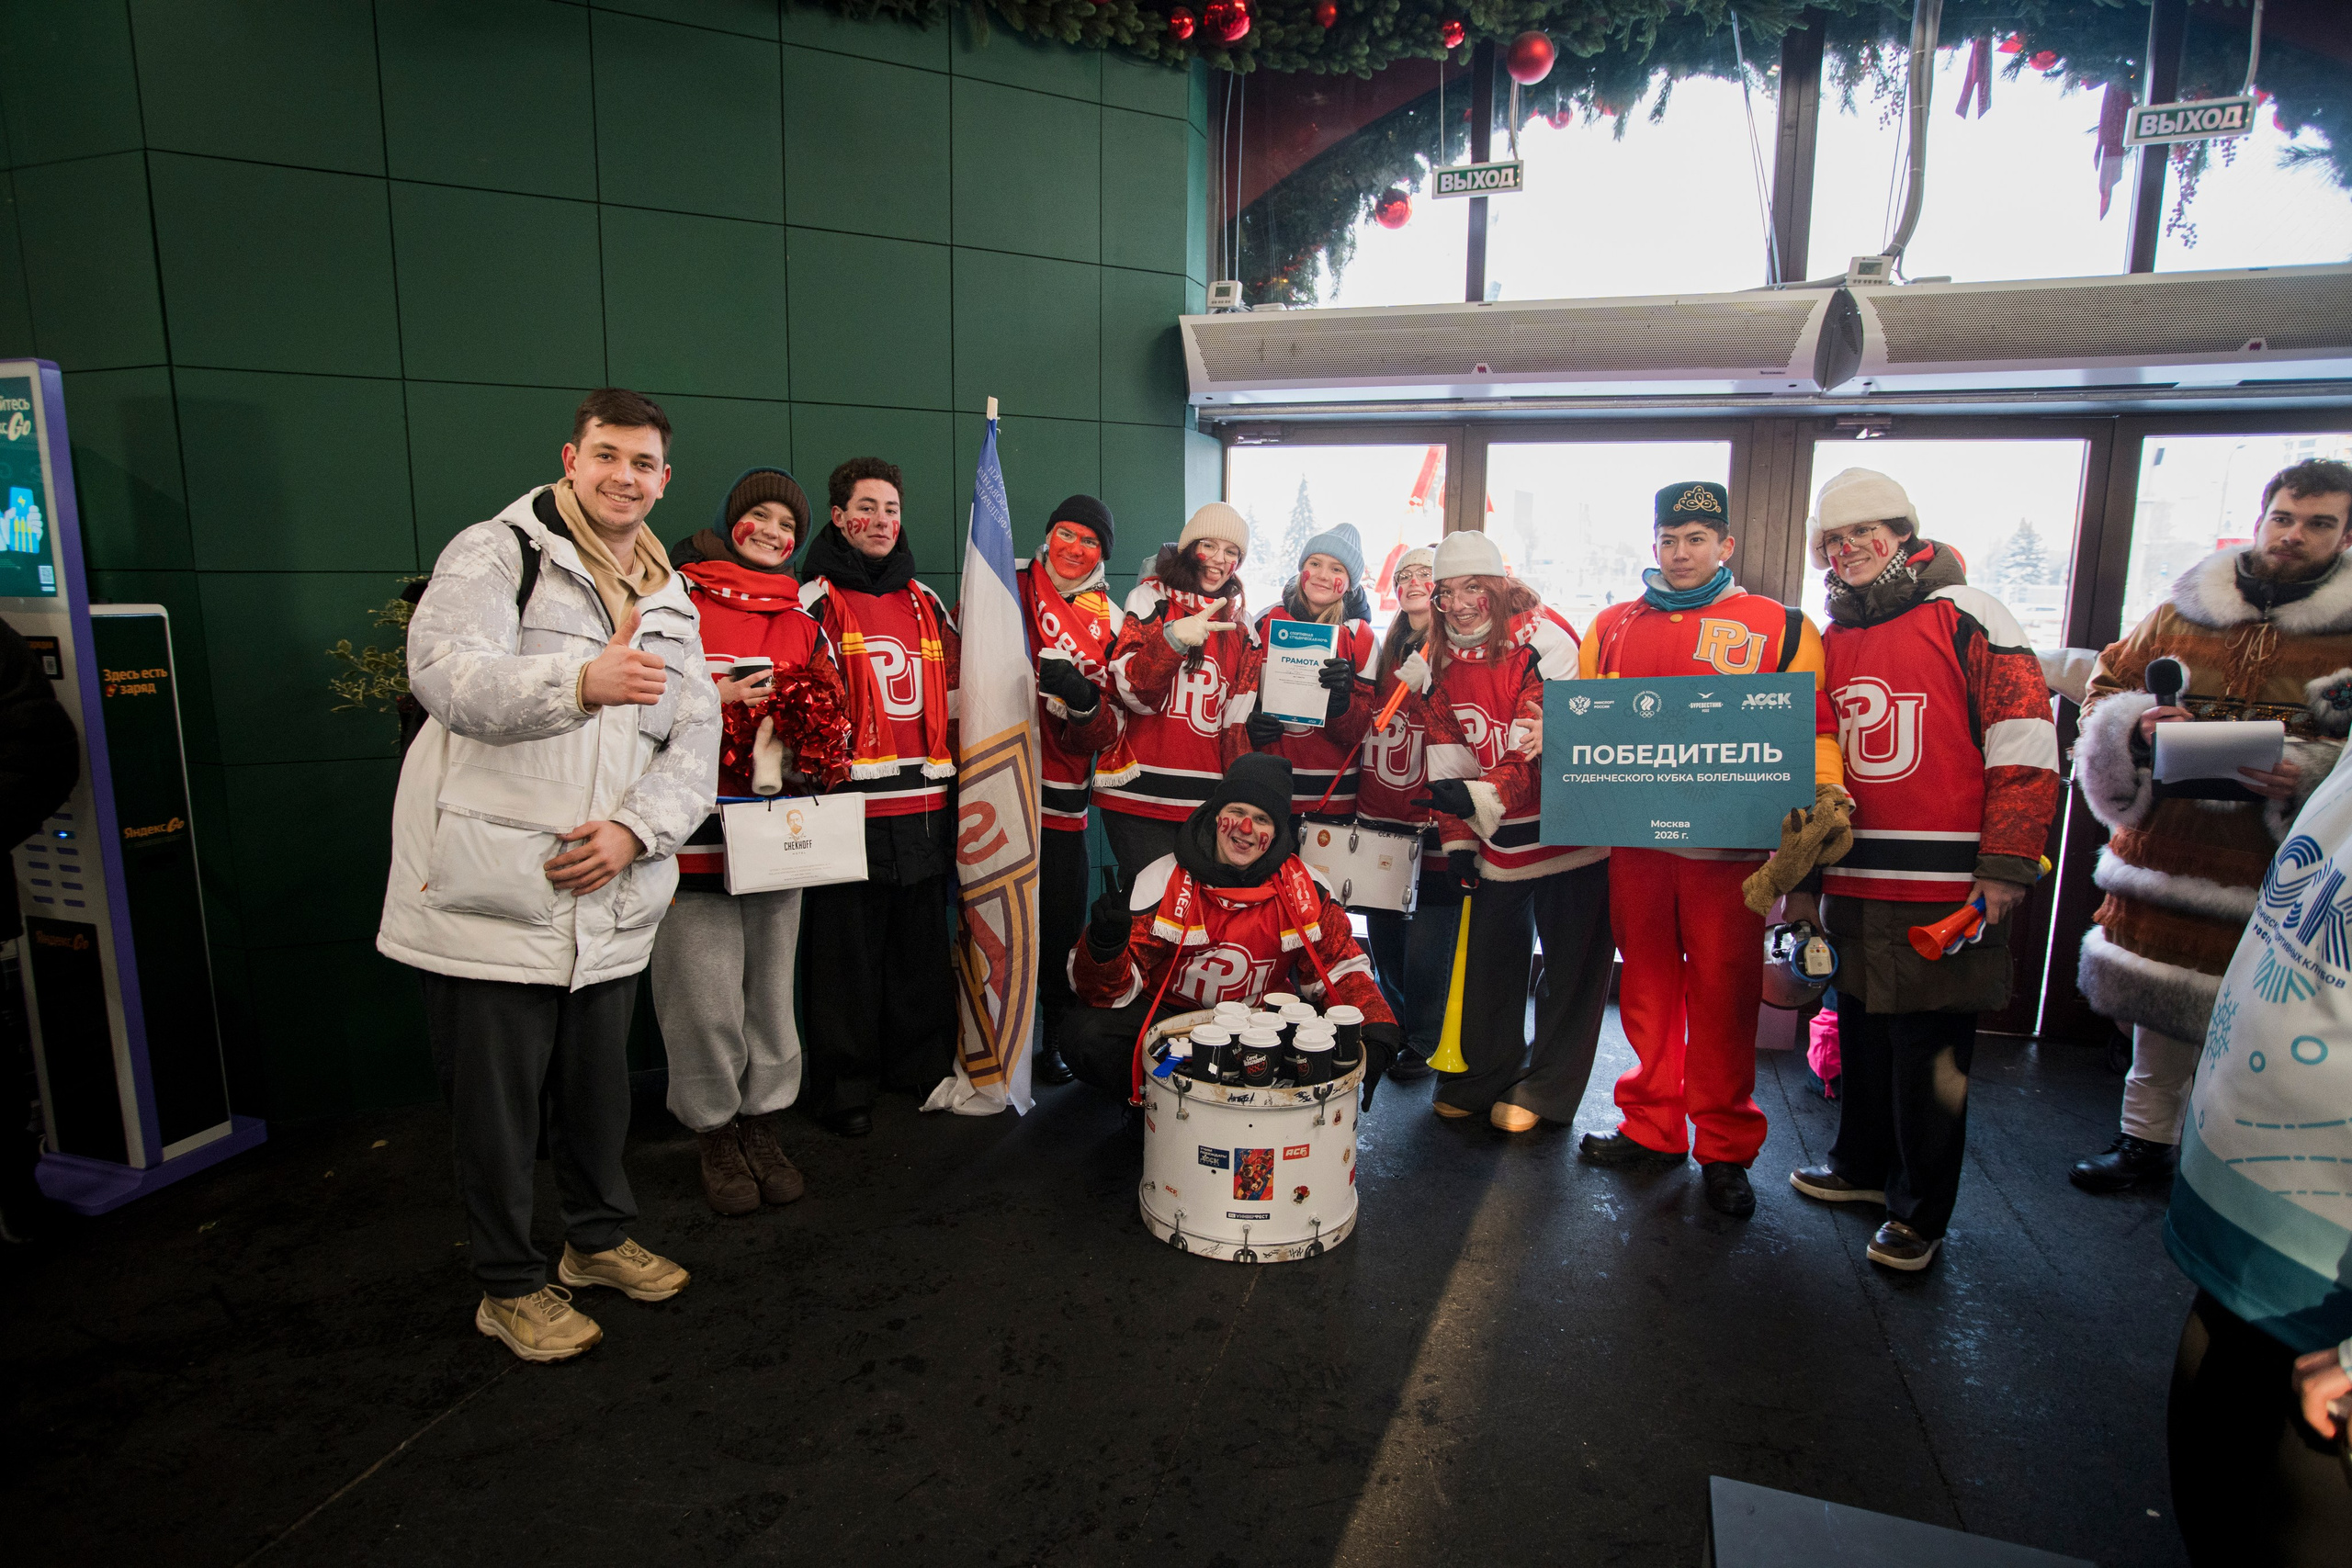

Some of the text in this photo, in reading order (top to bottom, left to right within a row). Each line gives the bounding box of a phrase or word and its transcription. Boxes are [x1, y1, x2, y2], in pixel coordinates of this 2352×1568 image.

[2139, 106, 2243, 137] ВЫХОД
[1440, 168, 1515, 192] ВЫХОД
[8, 412, 31, 441] Go
[1693, 617, 1768, 675] PU
[1281, 656, 1319, 667] ГРАМОТА
[103, 668, 168, 682] Здесь есть
[119, 682, 157, 696] заряд
[1742, 693, 1792, 705] АССК
[1830, 676, 1927, 783] PU
[1572, 742, 1783, 768] ПОБЕДИТЕЛЬ
[1562, 772, 1791, 784] СТУДЕНЧЕСКОГО КУБКА БОЛЕЛЬЩИКОВ
[123, 823, 166, 839] Яндекс
[1650, 819, 1690, 829] Москва
[1655, 830, 1679, 840] 2026
[784, 840, 812, 851] CHEKHOFF
